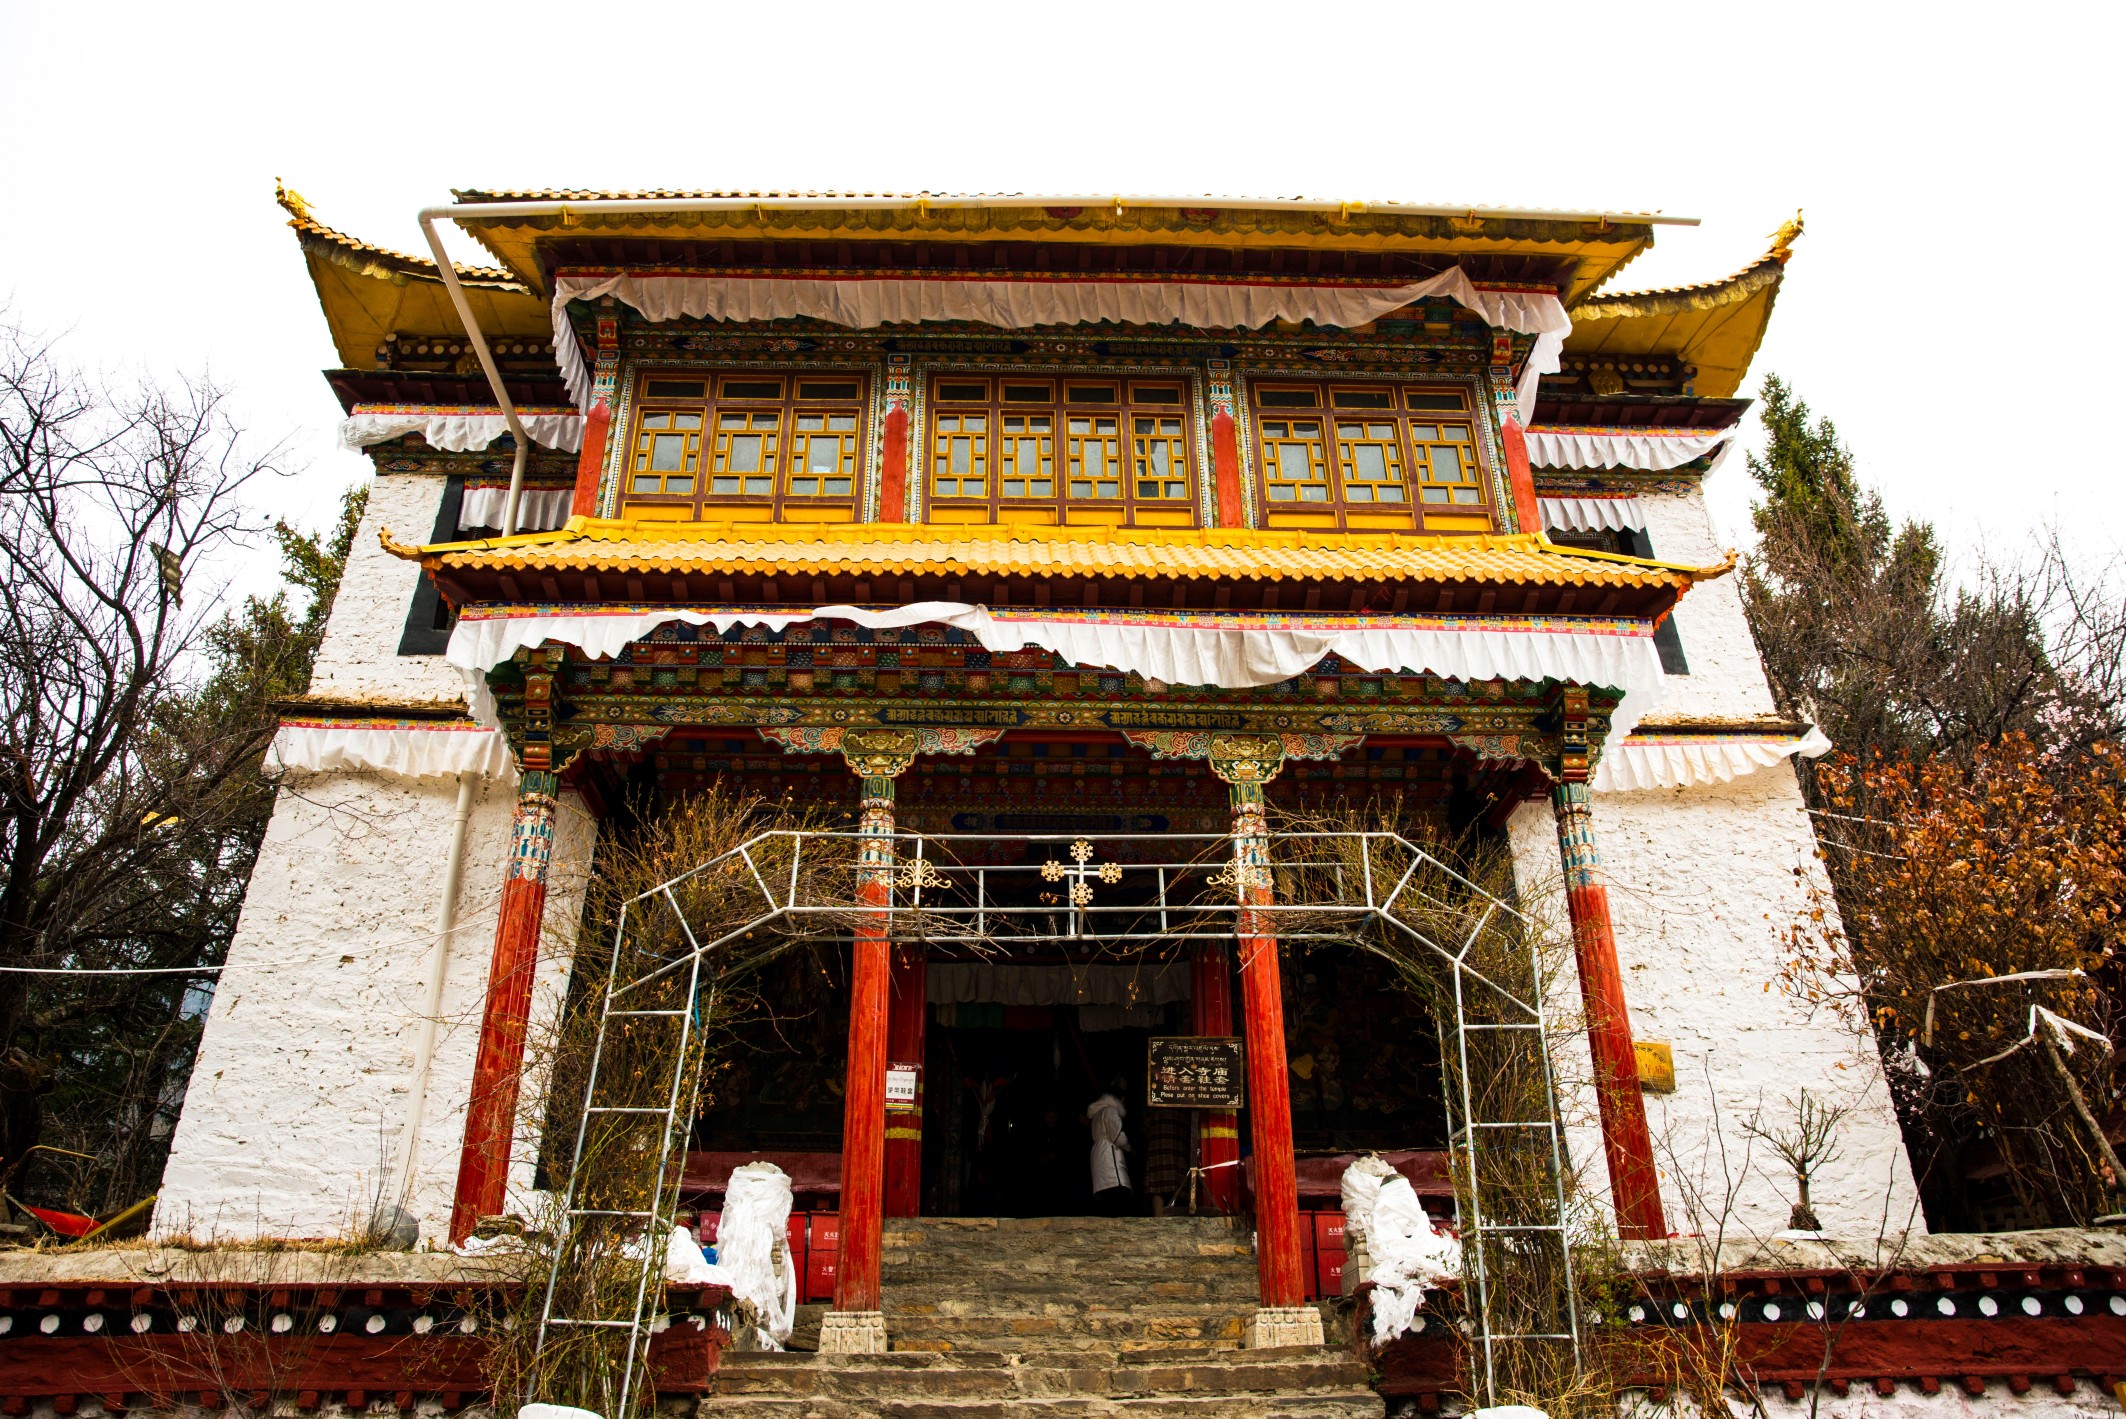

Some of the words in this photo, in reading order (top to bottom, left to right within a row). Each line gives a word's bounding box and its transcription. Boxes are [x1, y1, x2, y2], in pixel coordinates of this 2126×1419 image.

[1161, 1067, 1229, 1076] 进入寺庙
[1162, 1075, 1229, 1084] 请套鞋套
